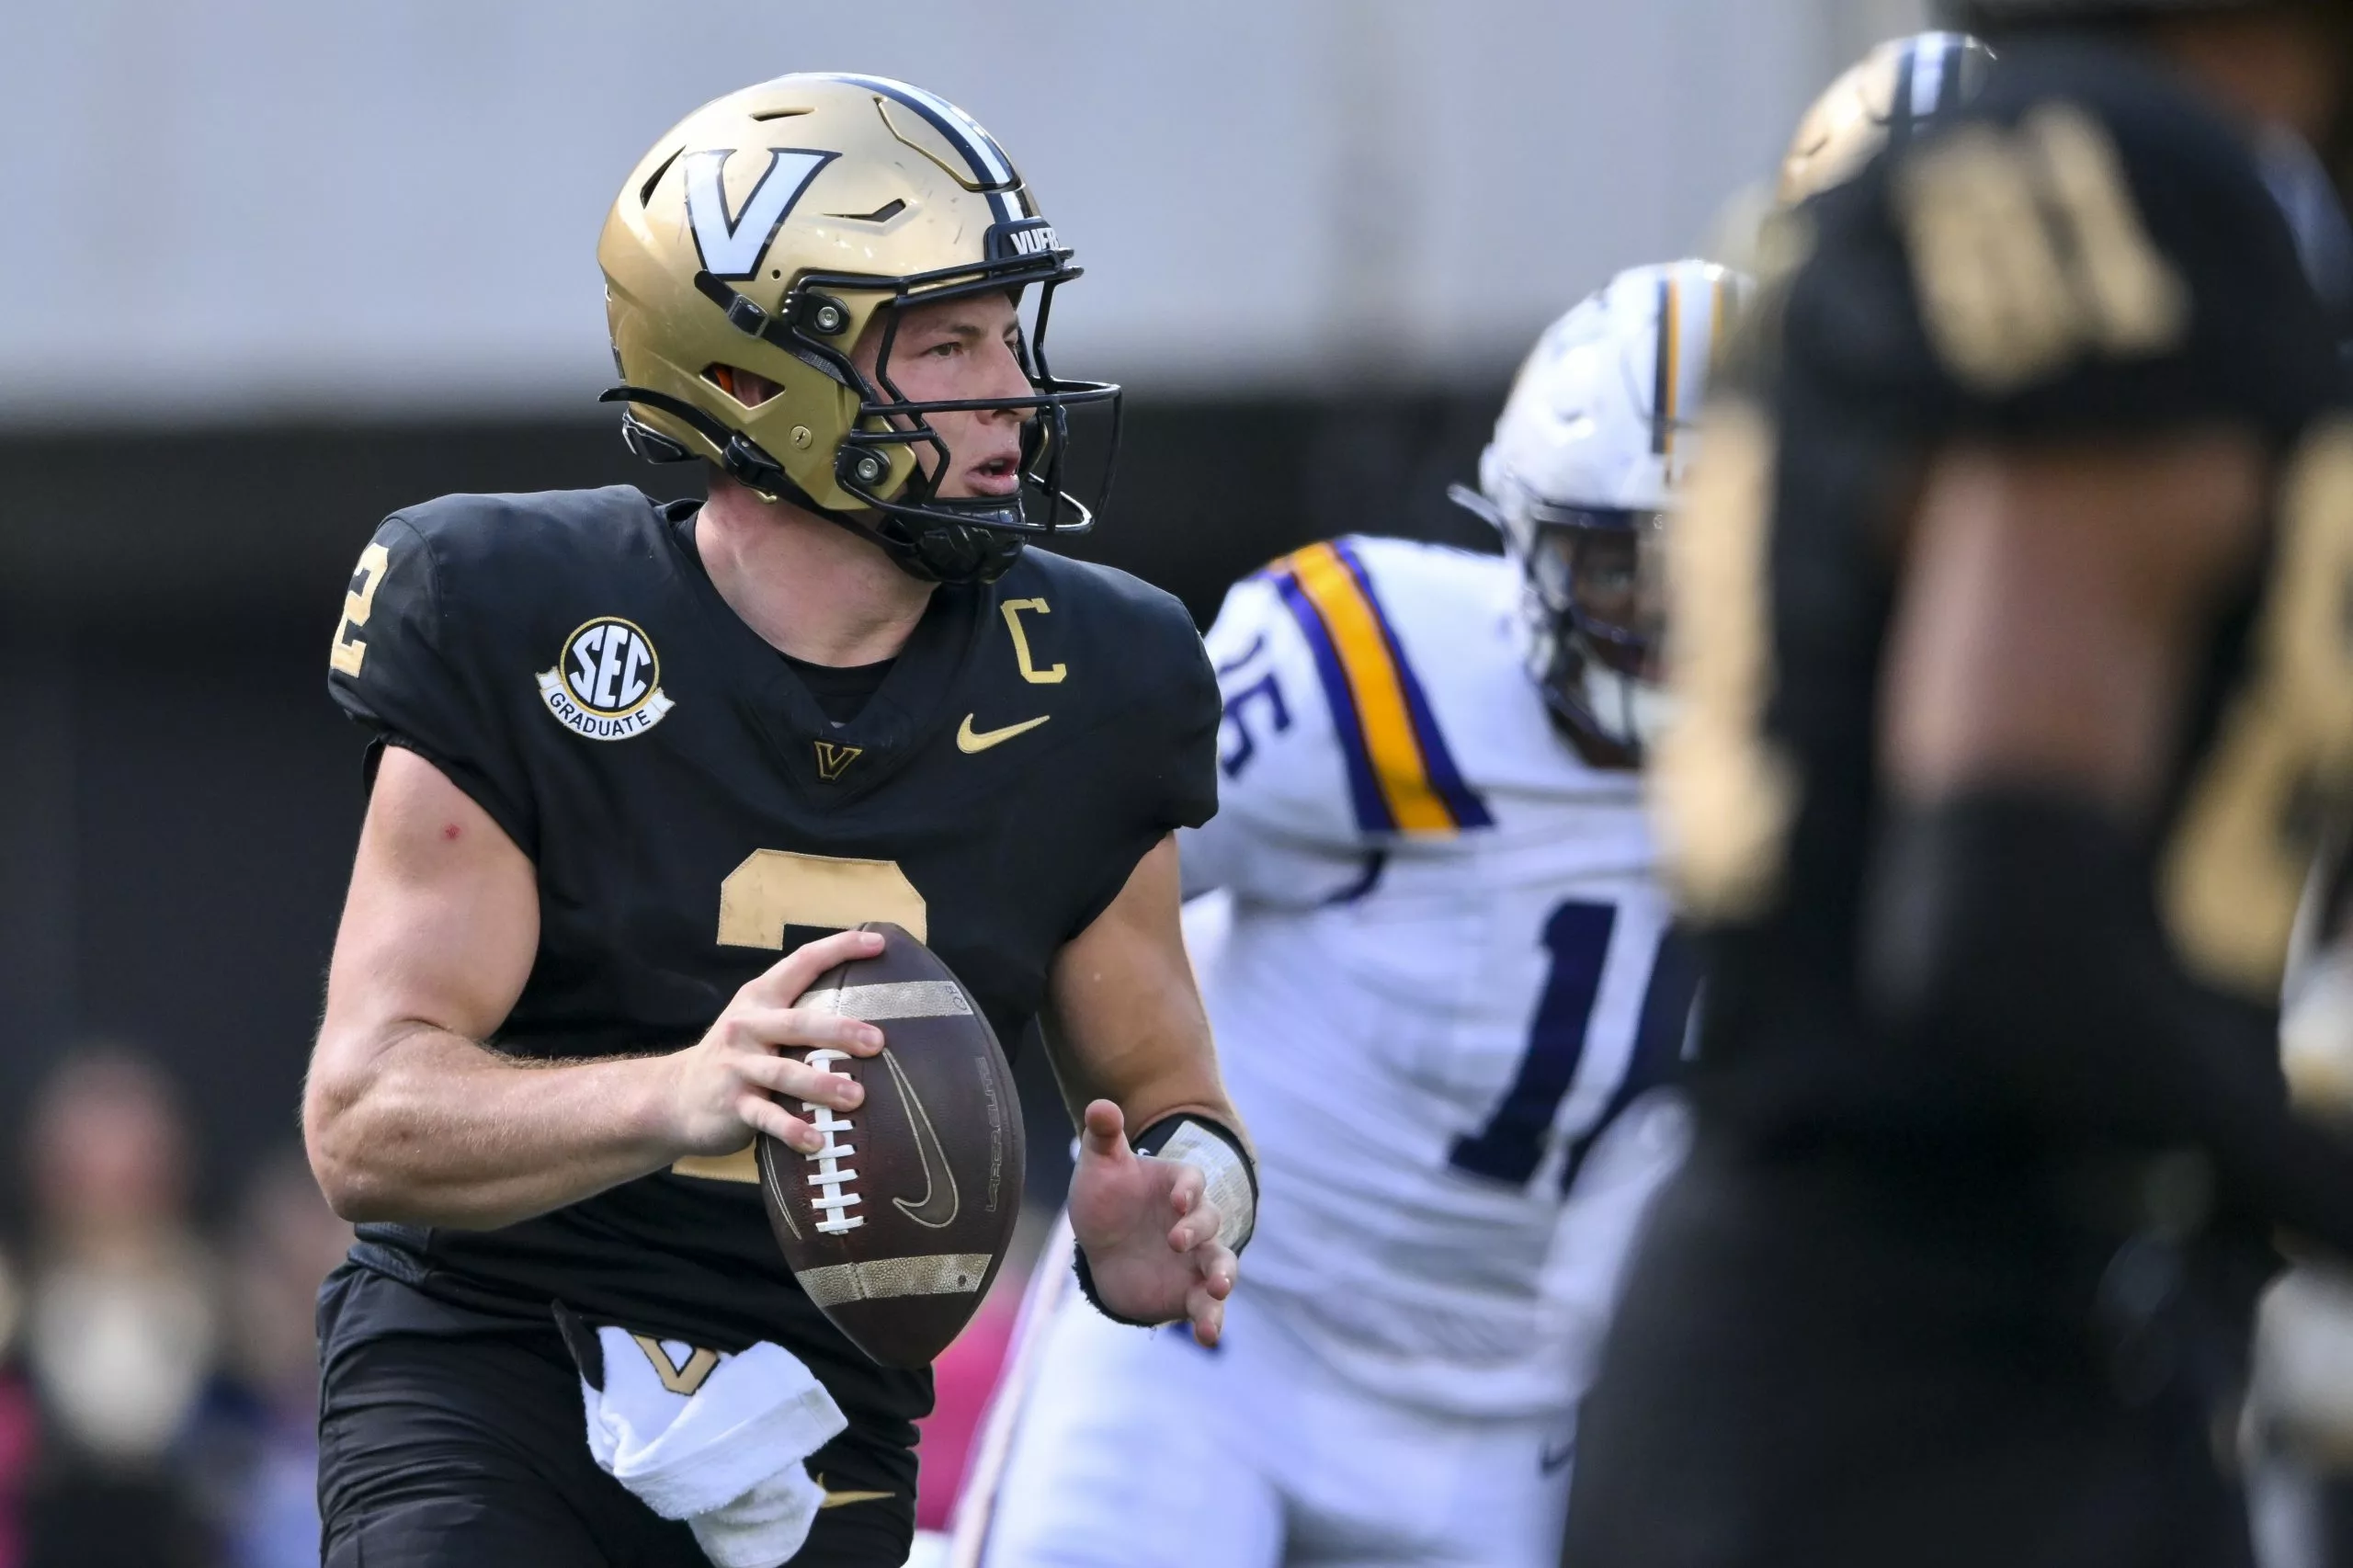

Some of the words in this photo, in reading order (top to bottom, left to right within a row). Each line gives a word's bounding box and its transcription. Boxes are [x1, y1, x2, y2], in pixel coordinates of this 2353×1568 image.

[683, 147, 842, 281] V
[330, 542, 389, 678] 2
[1000, 597, 1067, 683] C
[569, 625, 651, 708] SEC
[550, 692, 651, 736] GRADUATE
[814, 741, 863, 779] V
